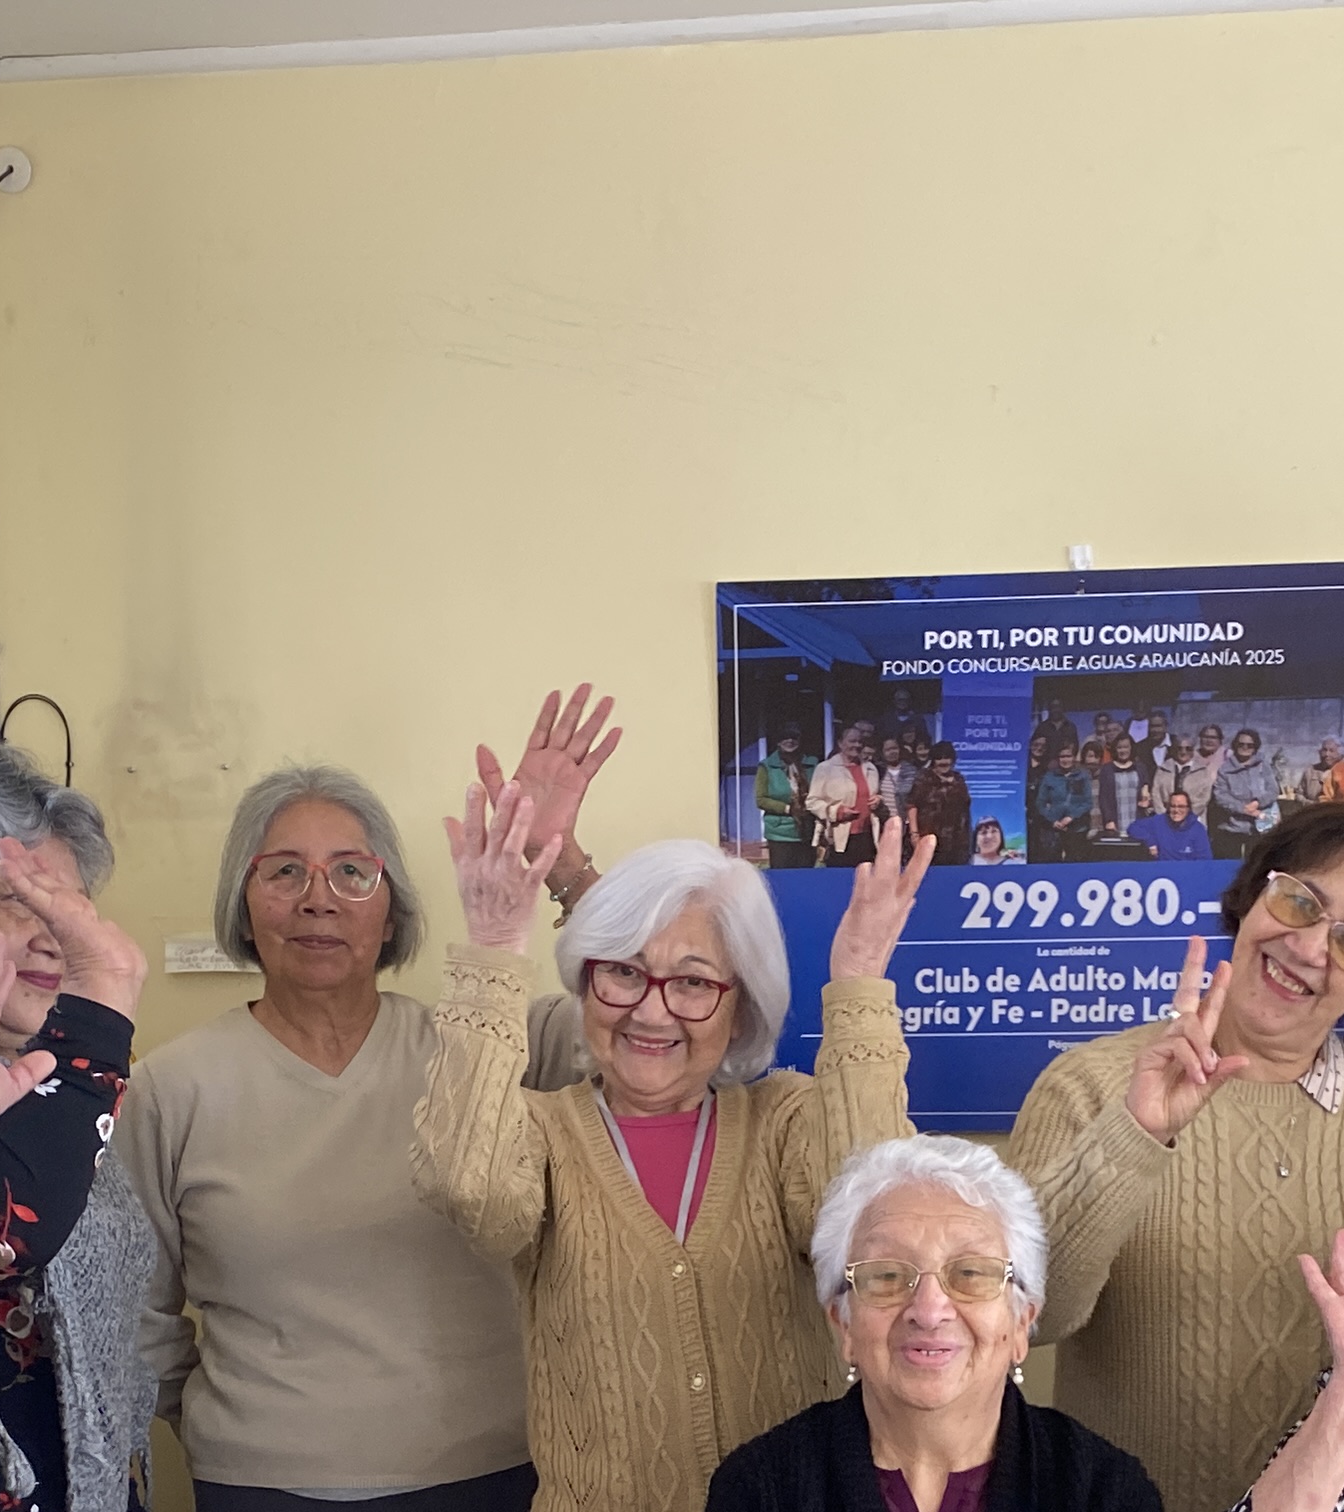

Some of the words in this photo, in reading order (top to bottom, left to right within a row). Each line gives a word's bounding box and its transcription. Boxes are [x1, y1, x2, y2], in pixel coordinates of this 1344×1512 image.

[924, 630, 973, 650] POR
[977, 629, 1005, 650] TI,
[1009, 627, 1059, 647] POR
[1062, 626, 1095, 646] TU
[1098, 622, 1245, 645] COMUNIDAD
[882, 659, 945, 676] FONDO
[947, 655, 1074, 674] CONCURSABLE
[1076, 653, 1137, 671] AGUAS
[1139, 648, 1242, 669] ARAUCANÍA
[1245, 649, 1286, 666] 2025
[953, 742, 1022, 752] COMUNIDAD
[992, 728, 1008, 738] TU
[959, 877, 1222, 929] 299.980.-
[1097, 946, 1111, 956] de
[914, 966, 980, 994] Club
[985, 966, 1020, 993] de
[1027, 965, 1126, 993] Adulto
[966, 1006, 986, 1032] y
[991, 999, 1025, 1024] Fe
[1050, 996, 1136, 1023] Padre
